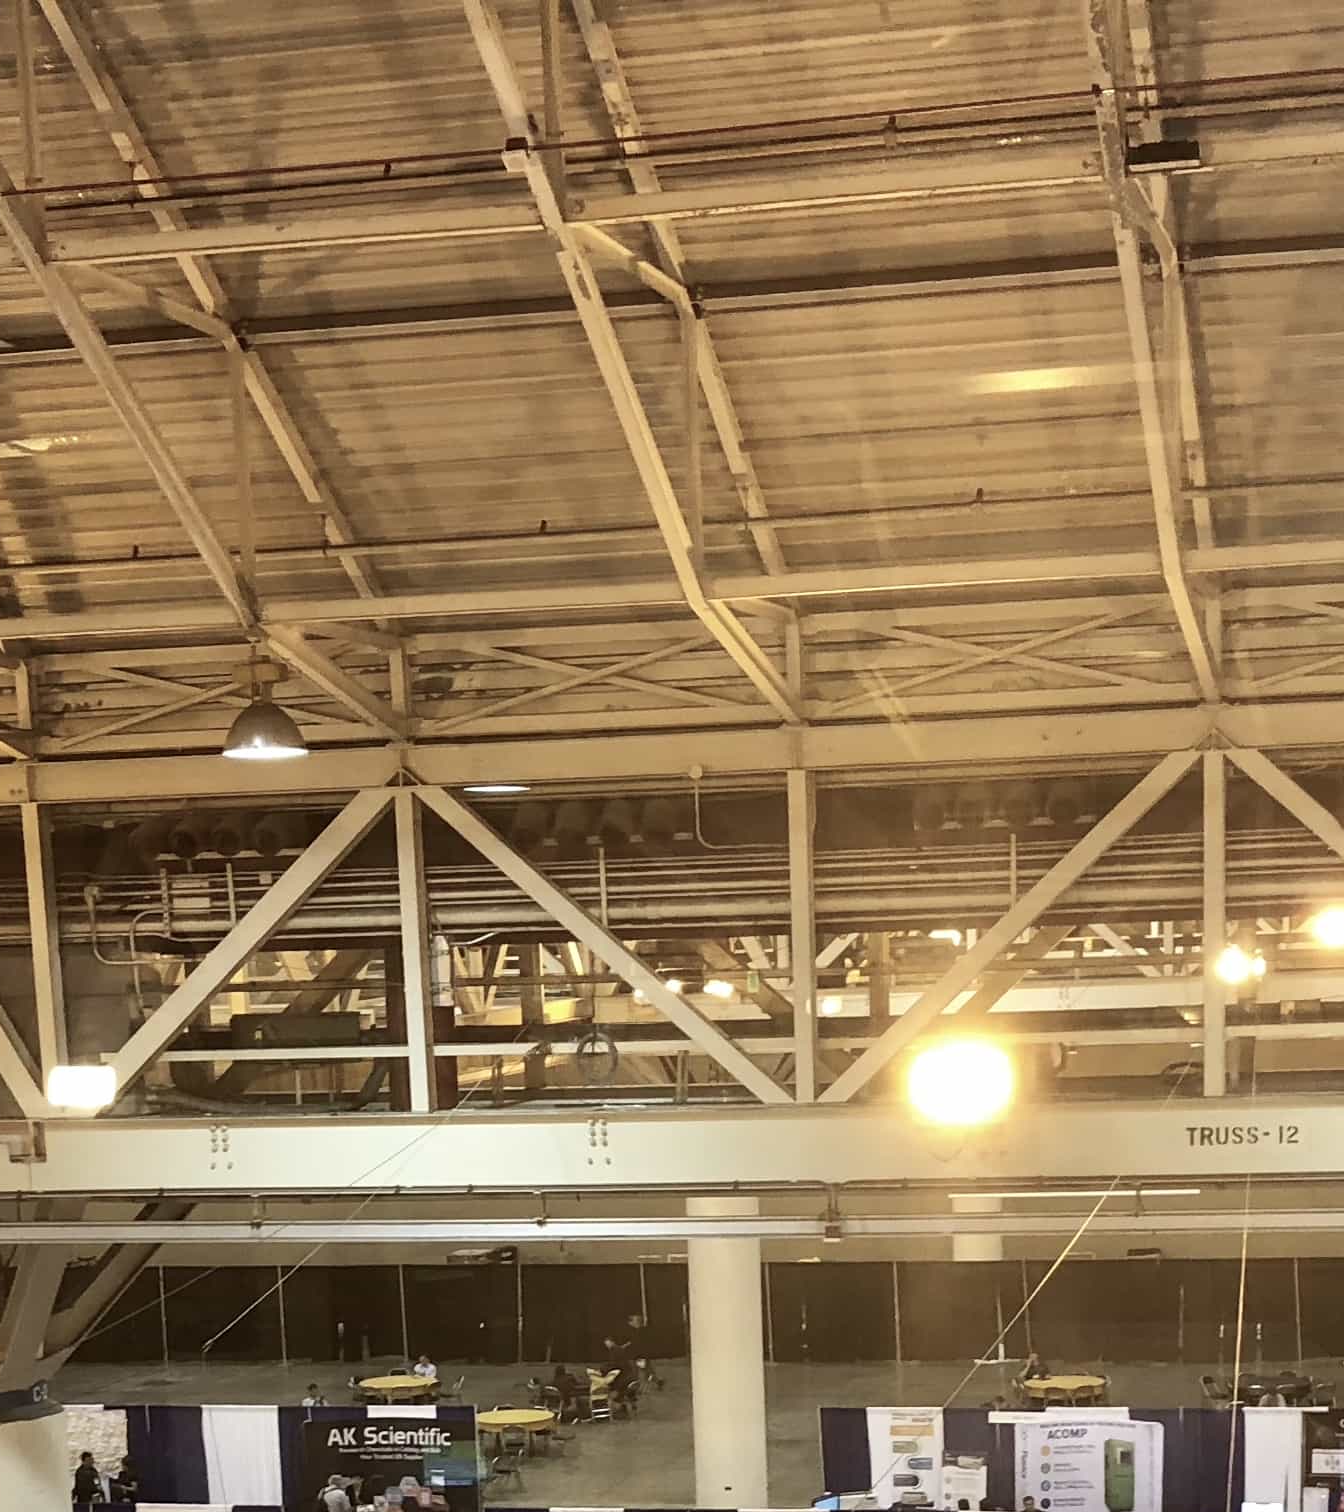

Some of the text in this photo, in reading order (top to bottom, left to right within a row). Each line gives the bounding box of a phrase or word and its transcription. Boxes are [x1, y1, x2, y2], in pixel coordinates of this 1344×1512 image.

[328, 1426, 452, 1447] AK Scientific
[1047, 1428, 1089, 1441] ACOMP
